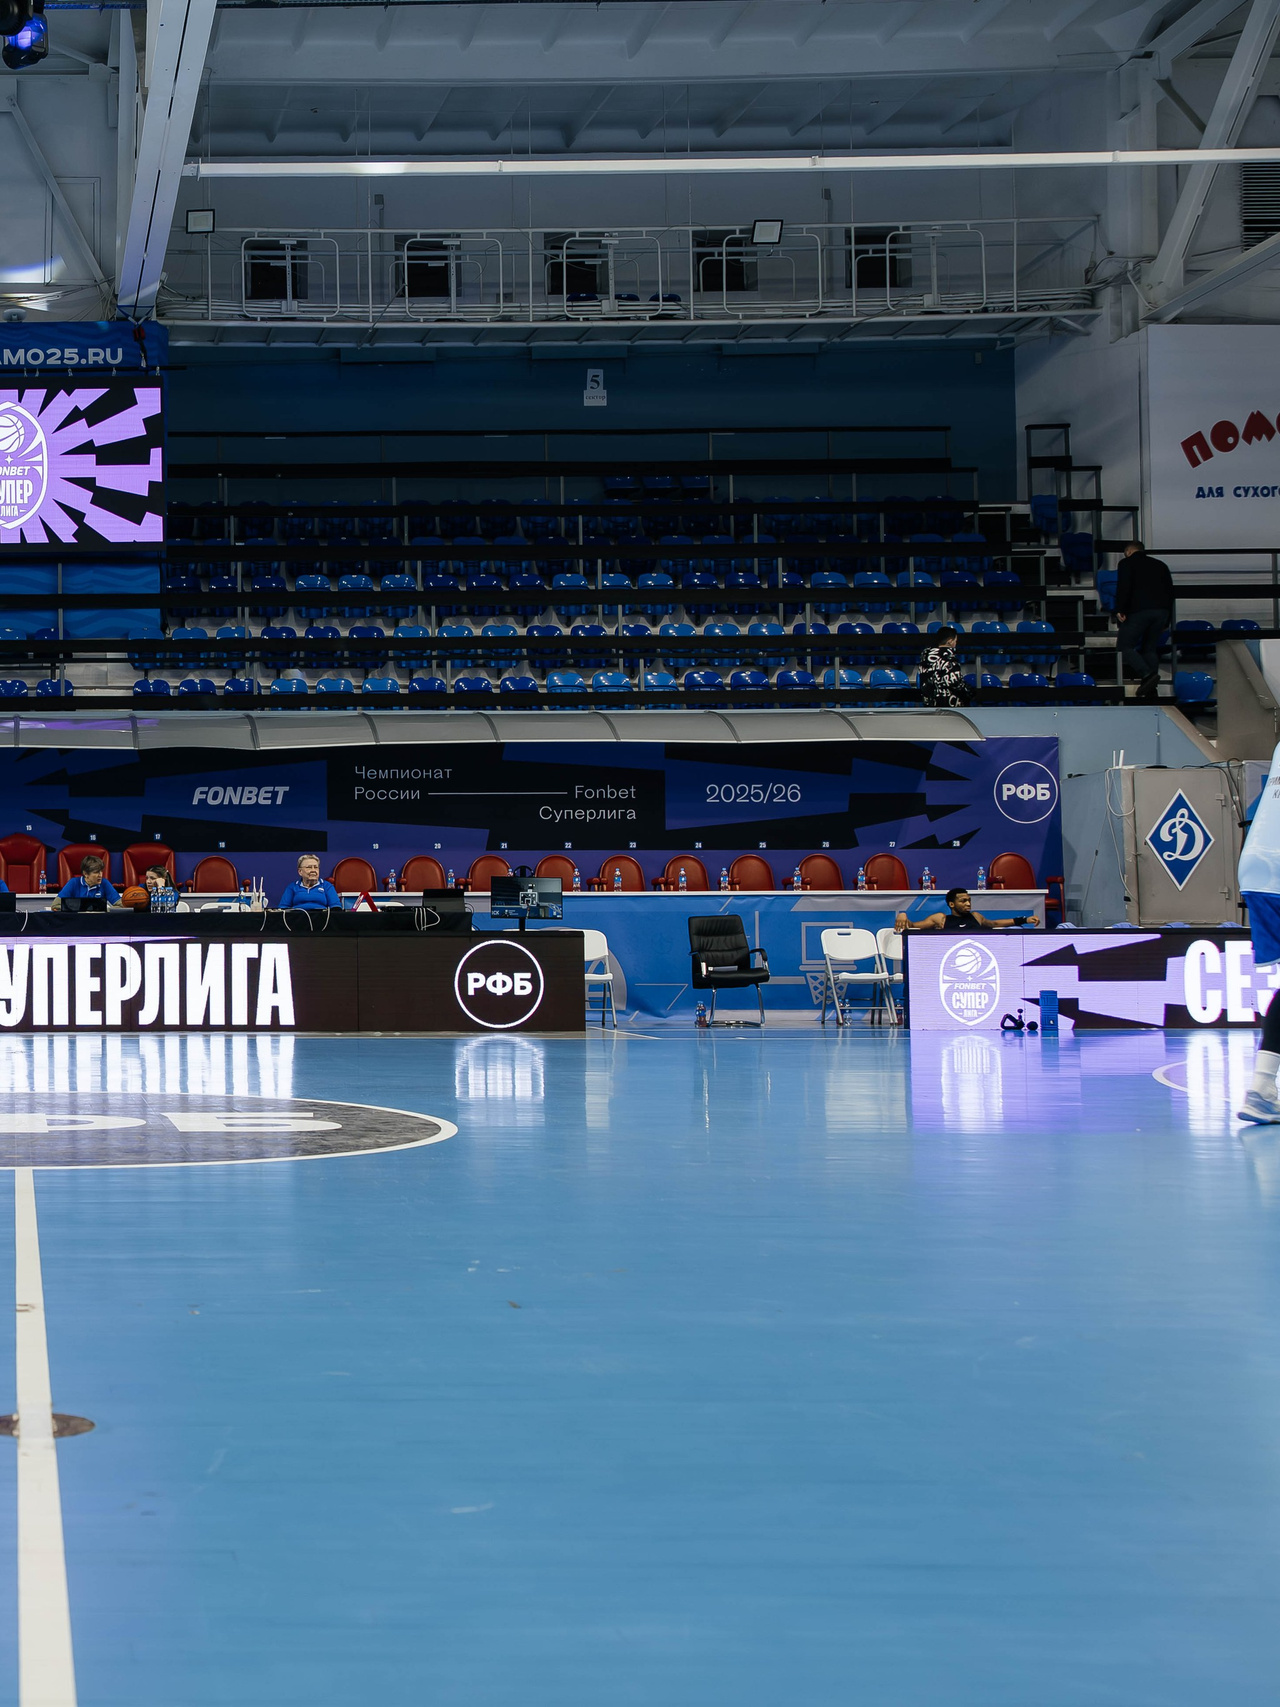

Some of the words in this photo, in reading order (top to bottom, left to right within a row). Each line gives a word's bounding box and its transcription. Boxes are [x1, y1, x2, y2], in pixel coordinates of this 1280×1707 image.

[589, 374, 600, 390] 5
[1180, 409, 1280, 469] ПОМ
[1195, 486, 1224, 499] ДЛЯ
[1233, 485, 1280, 498] СУХОГ
[0, 505, 19, 517] ЛИГА
[355, 765, 452, 780] Чемпионат
[192, 786, 290, 806] FONBET
[354, 786, 420, 800] России
[575, 784, 636, 799] Fonbet
[706, 782, 801, 804] 2025/26
[1001, 783, 1051, 801] РФБ
[539, 805, 637, 823] Суперлига
[466, 971, 533, 996] РФБ
[951, 991, 989, 1009] СУПЕР
